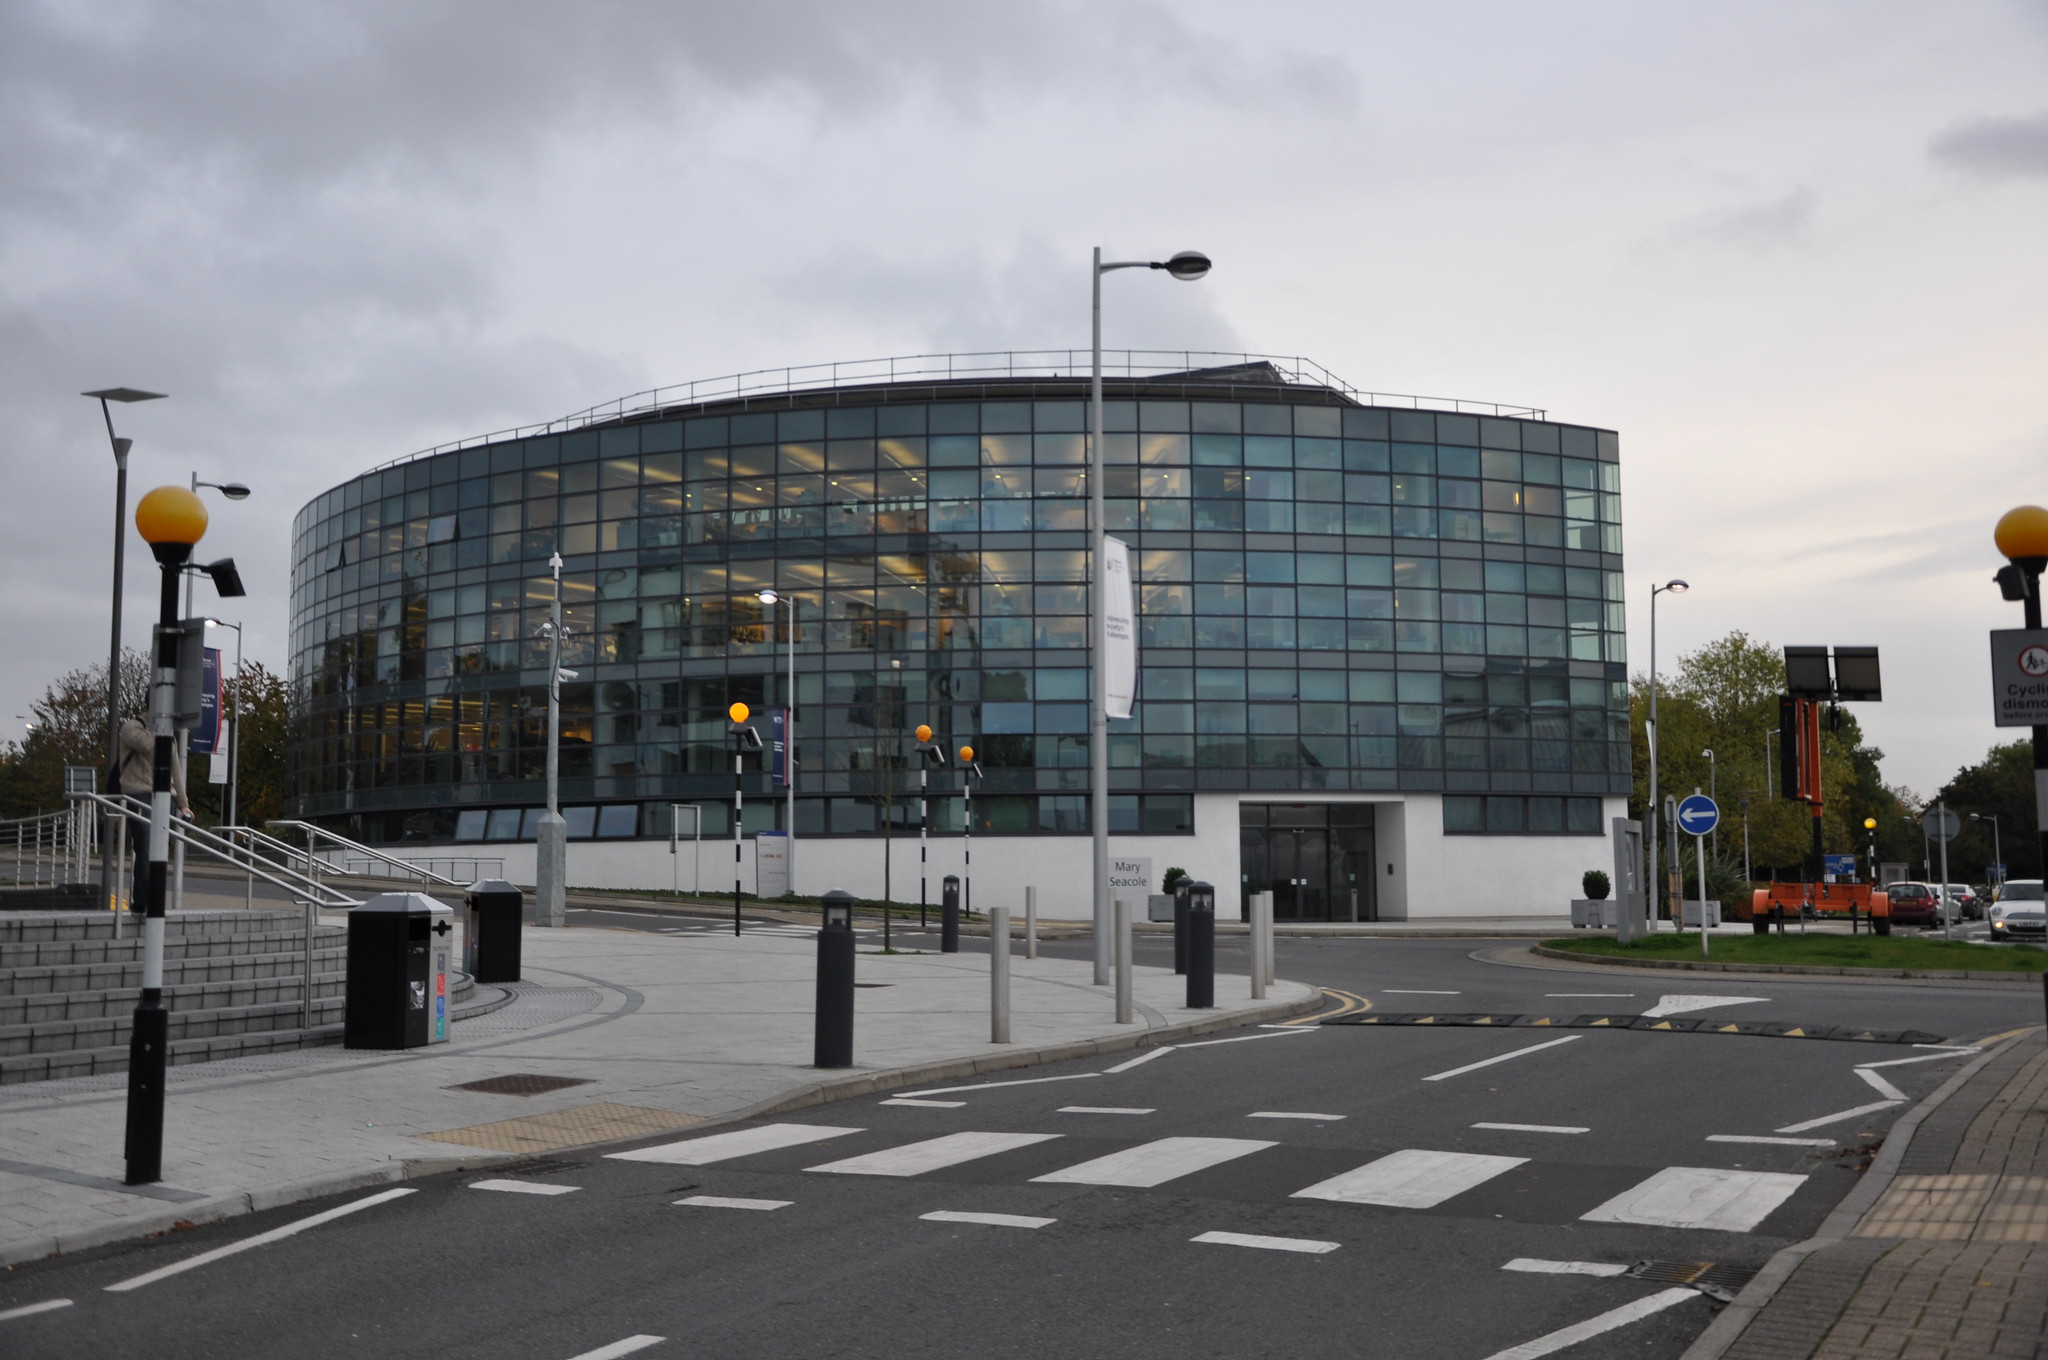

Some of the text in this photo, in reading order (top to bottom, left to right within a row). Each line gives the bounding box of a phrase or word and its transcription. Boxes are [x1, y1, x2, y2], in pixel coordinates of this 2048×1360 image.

[2007, 683, 2048, 698] Cycli
[1115, 861, 1141, 874] Mary
[1109, 876, 1147, 887] Seacole
